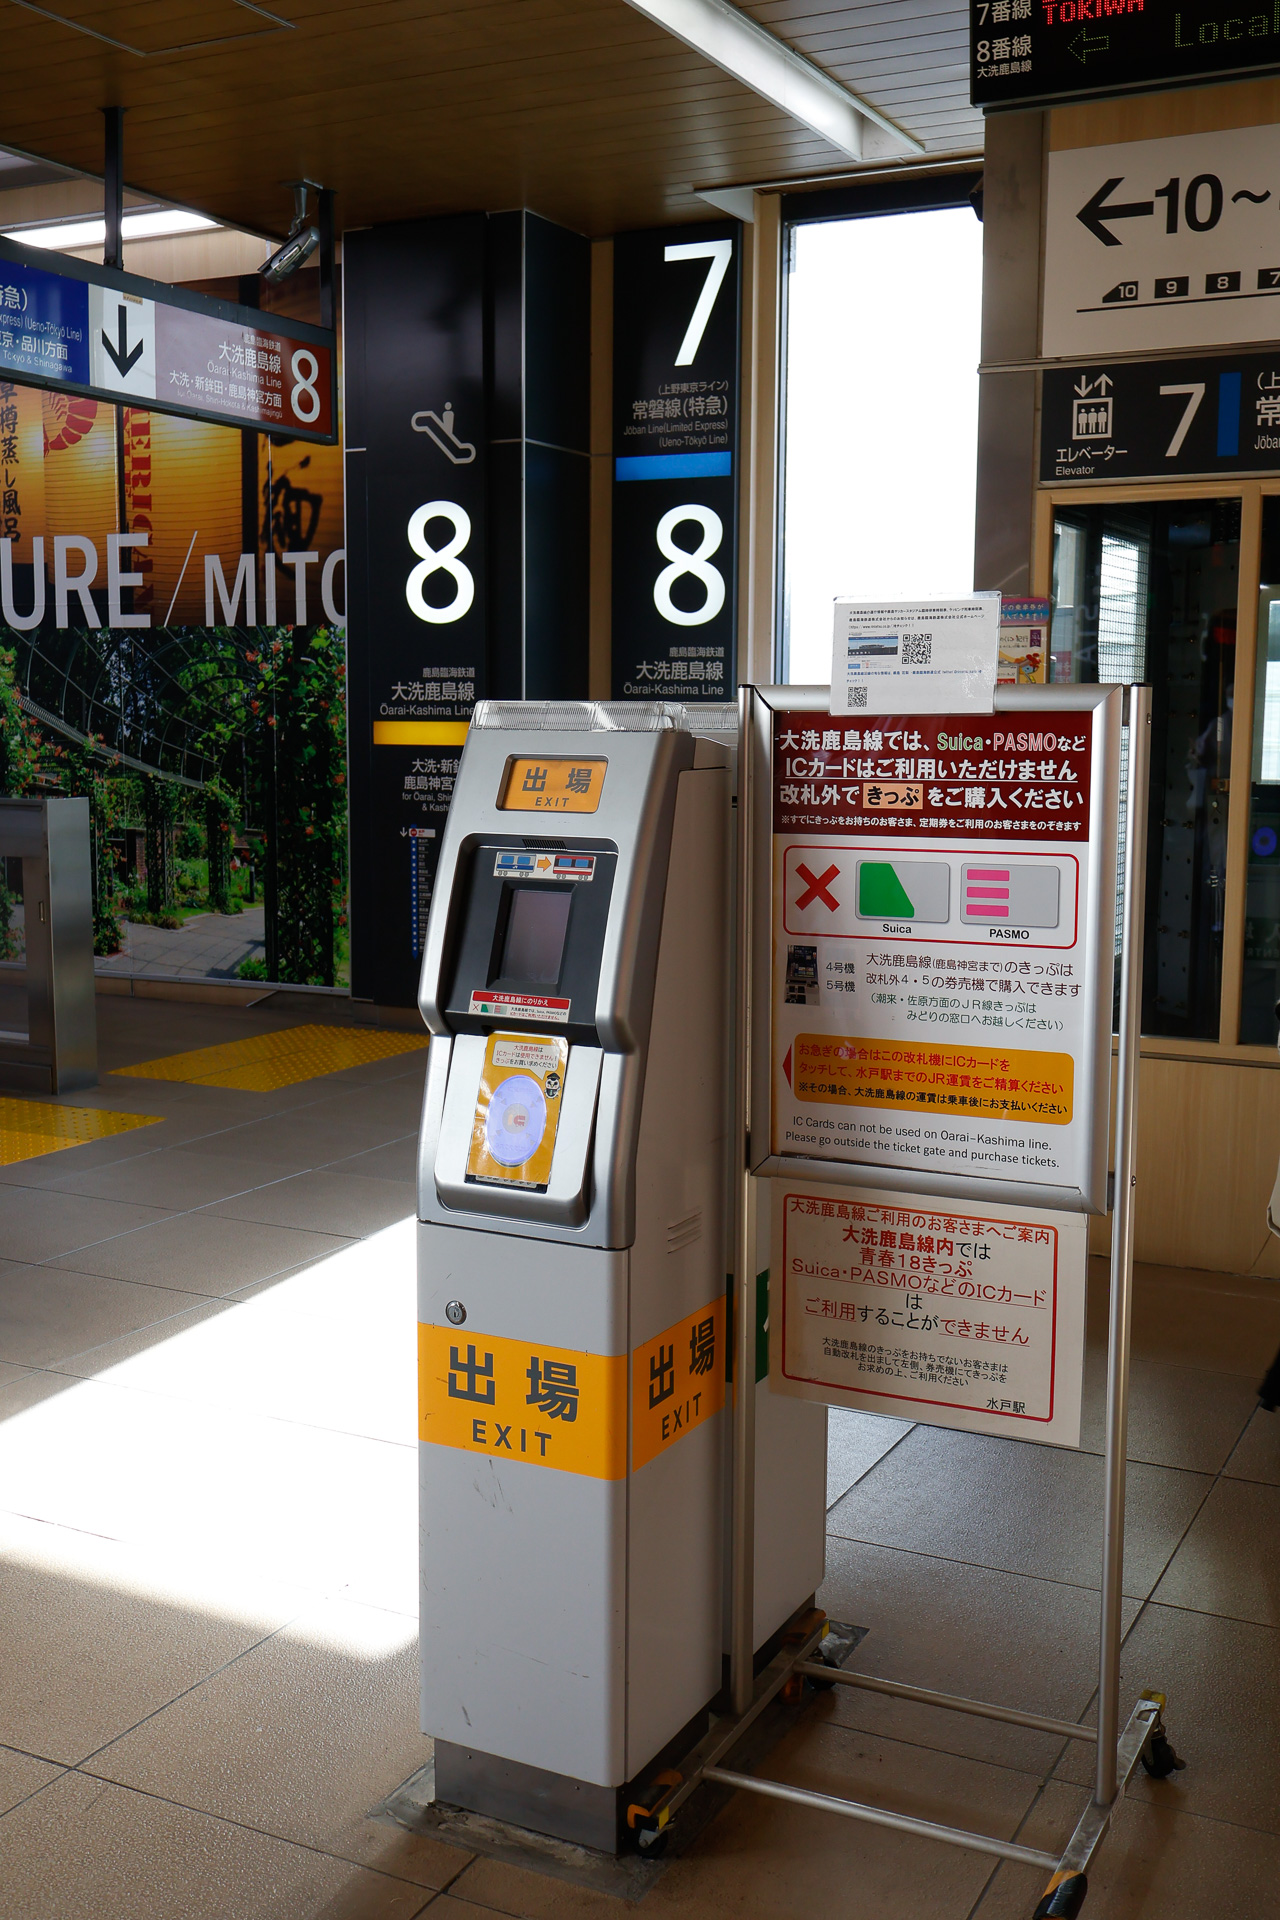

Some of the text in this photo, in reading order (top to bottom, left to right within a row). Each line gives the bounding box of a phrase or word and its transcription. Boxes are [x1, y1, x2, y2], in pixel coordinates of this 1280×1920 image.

[977, 0, 1032, 25] 7番線
[1175, 0, 1280, 48] Local
[976, 35, 1032, 62] 8番線
[977, 60, 1032, 78] 大洗鹿島線
[1118, 285, 1137, 298] 10
[1166, 281, 1178, 294] 9
[1217, 276, 1229, 290] 8
[664, 240, 732, 367] 7
[27, 356, 32, 364] &
[34, 357, 72, 373] Shinagawa
[218, 341, 282, 374] 大洗鹿島線
[266, 376, 282, 389] Line
[290, 349, 321, 423] 8
[658, 380, 729, 395] (上野東京ライン)
[632, 395, 728, 420] 常磐線(特急)
[1160, 383, 1206, 457] 7
[709, 433, 728, 445] Line)
[1056, 445, 1128, 462] エレベーター
[1055, 466, 1095, 476] Elevator
[406, 501, 475, 624] 8
[653, 504, 726, 627] 8
[669, 647, 724, 657] 鹿島臨海鉄道
[422, 667, 475, 678] 鹿島臨海鉄道
[636, 661, 723, 680] 大洗鹿島線
[391, 681, 475, 701] 大洗鹿島線
[624, 682, 724, 695] Ōarai-Kashima Line
[380, 703, 474, 716] Ōarai-Kashima Line
[786, 757, 1078, 780] ICカードはご利用いただけません
[404, 776, 457, 790] 鹿島神宮
[522, 767, 592, 794] 出場
[402, 792, 411, 800] for
[535, 797, 569, 807] EXIT
[422, 803, 427, 811] &
[882, 923, 1030, 940] Suica PASMO
[826, 962, 855, 974] 4号機
[826, 980, 856, 993] 5号機
[492, 994, 548, 1007] 大洗鹿島線にのりかえ
[906, 1010, 1064, 1032] みどりの窓口へお越しください）
[514, 1045, 543, 1053] 大洗鹿島線は
[799, 1043, 1010, 1072] お急ぎの場合はこの改札機にICカードを
[799, 1062, 1063, 1095] タッチして、水戸駅までのJR運賃をご精算ください
[793, 1116, 803, 1126] IC
[805, 1117, 834, 1129] Cards
[838, 1121, 857, 1131] can
[860, 1124, 876, 1133] not
[879, 1124, 892, 1135] be
[895, 1128, 920, 1137] used
[924, 1130, 937, 1139] on
[1028, 1138, 1051, 1150] line.
[786, 1131, 1060, 1168] Please go outside the ticket gate and purchase tickets.
[790, 1198, 1050, 1245] 大洗鹿島線ご利用のお客さまへご案内
[842, 1225, 991, 1260] 大洗鹿島線内では
[860, 1247, 973, 1277] 青春18きっぷ
[792, 1258, 1047, 1306] Suica・PASMOなどのICカード
[906, 1293, 923, 1310] は
[805, 1297, 1029, 1344] ご利用することができません
[649, 1316, 715, 1410] 出場
[448, 1344, 579, 1422] 出場
[857, 1363, 969, 1387] お求めの上、ご利用ください
[662, 1392, 702, 1441] EXIT
[986, 1398, 1026, 1415] 水戸駅
[472, 1419, 552, 1457] EXIT
